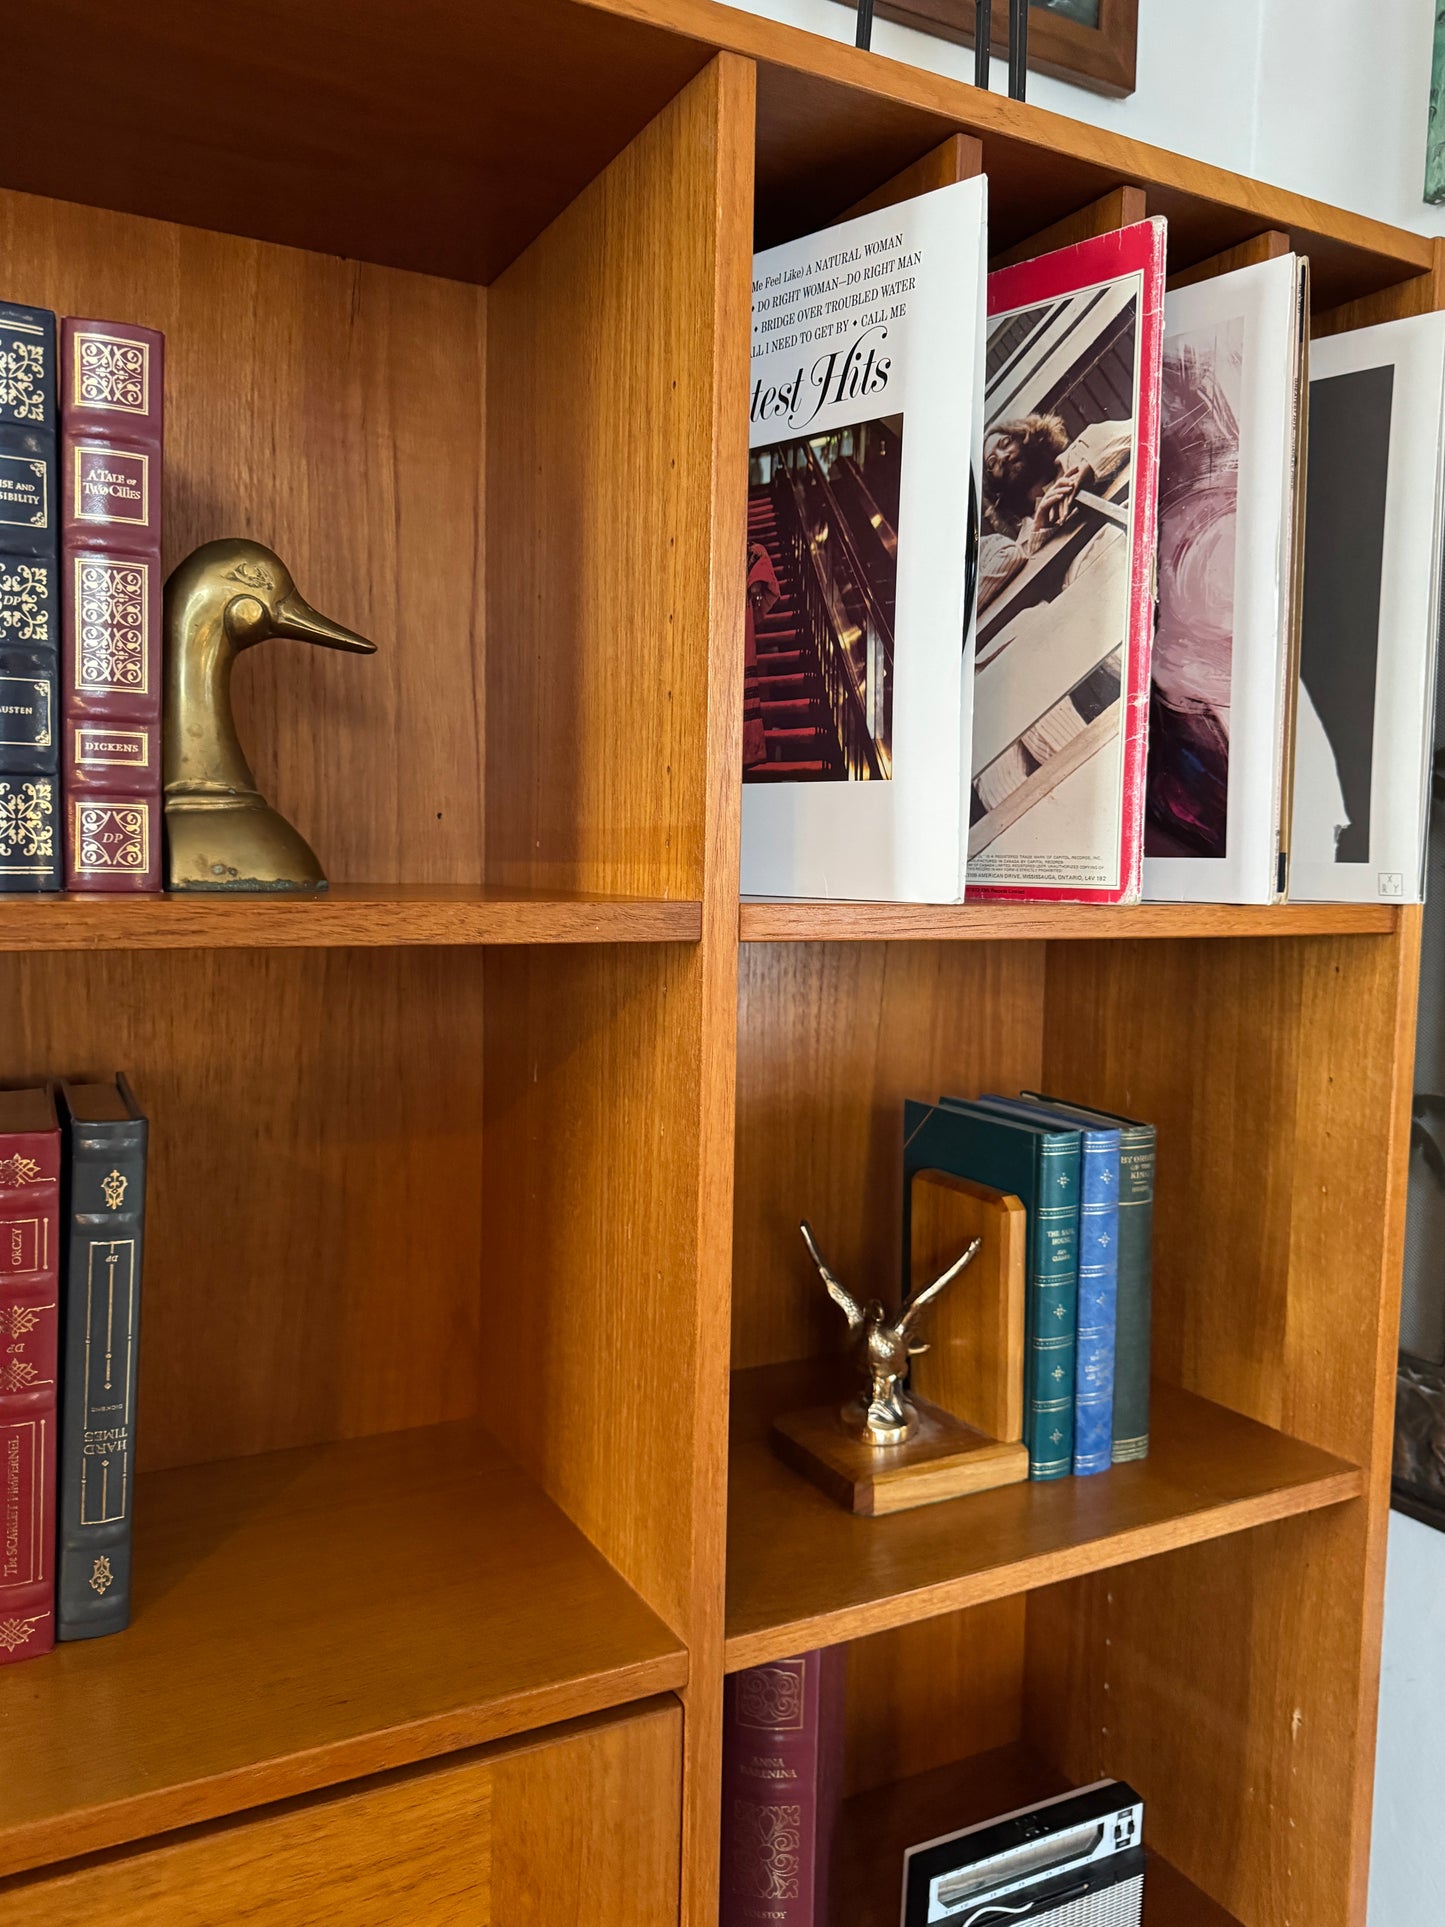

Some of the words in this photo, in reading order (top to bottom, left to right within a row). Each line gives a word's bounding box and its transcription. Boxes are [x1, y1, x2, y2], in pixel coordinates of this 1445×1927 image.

[765, 273, 781, 288] Feel
[784, 266, 804, 283] Like)
[805, 264, 812, 276] A
[815, 248, 861, 273] NATURAL
[864, 233, 903, 257] WOMAN
[757, 298, 770, 313] DO
[772, 289, 801, 308] RIGHT
[863, 260, 895, 280] RIGHT
[897, 251, 922, 270] MAN
[761, 312, 795, 333] BRIDGE
[797, 305, 823, 323] OVER
[825, 288, 879, 314] TROUBLED
[880, 277, 916, 298] WATER
[750, 344, 764, 358] LL
[766, 342, 769, 354] I
[771, 334, 798, 353] NEED
[800, 330, 812, 344] TO
[814, 324, 834, 340] GET
[836, 319, 849, 334] BY
[861, 309, 888, 328] CALL
[890, 303, 907, 319] ME
[750, 367, 805, 423] test
[788, 325, 892, 430] Hits
[87, 470, 98, 481] A
[15, 482, 36, 492] AND
[0, 704, 33, 716] USTEN
[84, 741, 139, 753] DICKENS
[101, 831, 124, 844] DP
[11, 1228, 22, 1266] ORCZY
[84, 1427, 128, 1442] TIMES
[83, 1439, 127, 1455] HARD
